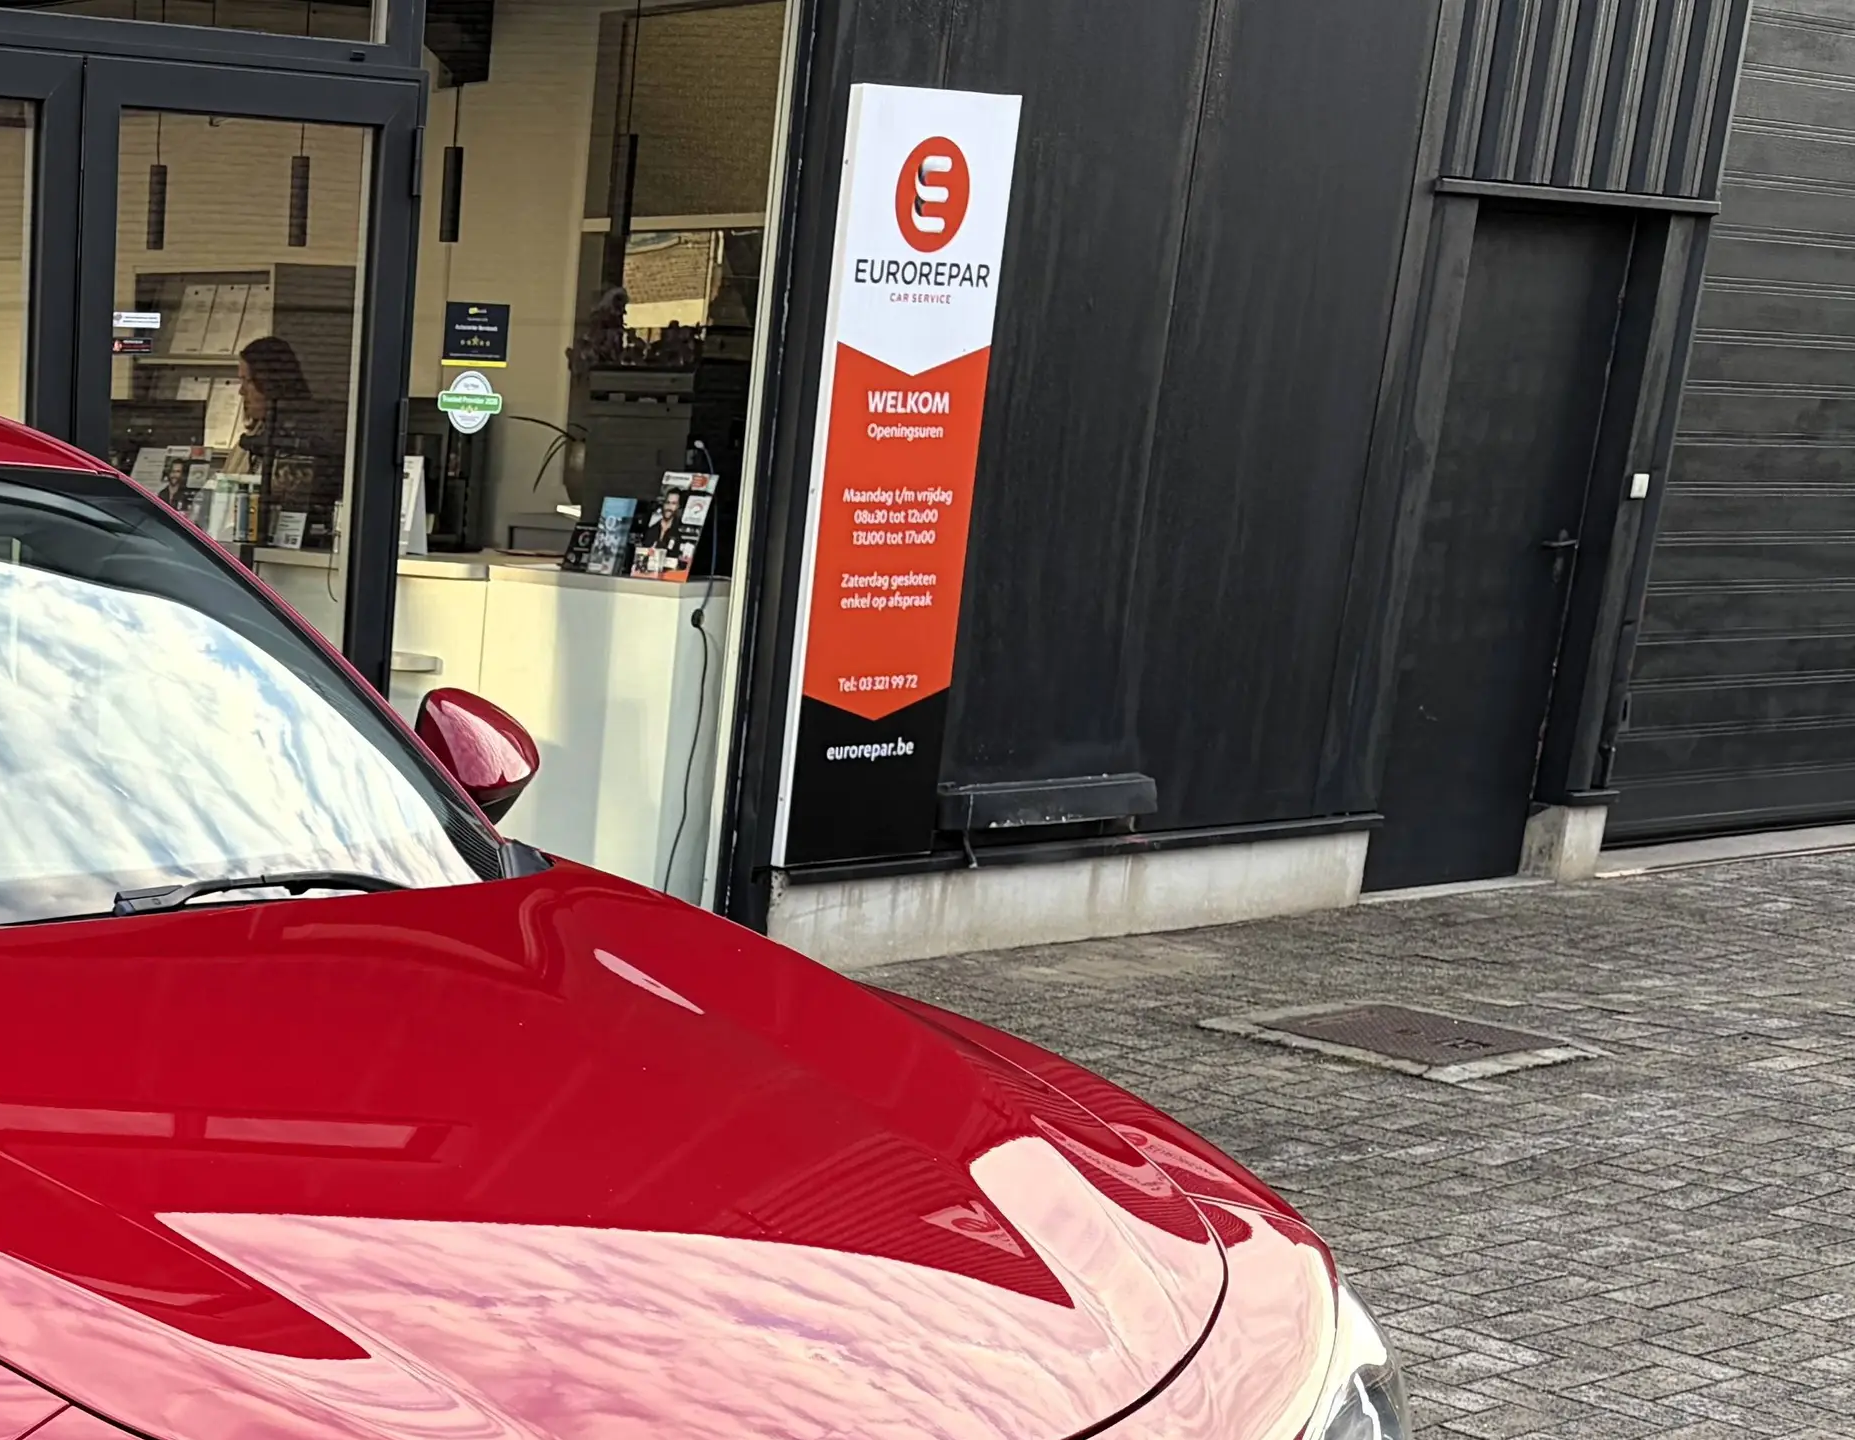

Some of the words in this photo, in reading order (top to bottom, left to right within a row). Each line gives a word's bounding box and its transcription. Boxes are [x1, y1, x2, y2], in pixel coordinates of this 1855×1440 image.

[855, 259, 990, 289] EUROREPAR
[889, 292, 909, 303] CAR
[912, 293, 951, 304] SERVICE
[867, 390, 950, 415] WELKOM
[867, 422, 944, 442] Openingsuren
[843, 488, 893, 506] Maandag
[895, 488, 914, 503] t/m
[916, 488, 953, 506] vrijdag
[854, 510, 887, 525] 08u30
[889, 510, 905, 524] tot
[907, 509, 938, 524] 12u00
[886, 531, 903, 545] tot
[905, 530, 935, 544] 17u00
[841, 573, 889, 590] Zaterdag
[891, 573, 936, 590] gesloten
[840, 594, 871, 609] enkel
[871, 596, 886, 611] op
[887, 592, 933, 611] afspraak
[838, 677, 857, 692] Tel:
[858, 677, 873, 691] 03
[874, 676, 889, 690] 321
[890, 676, 904, 689] 99
[905, 675, 918, 689] 72
[826, 737, 915, 761] eurorepar.be
